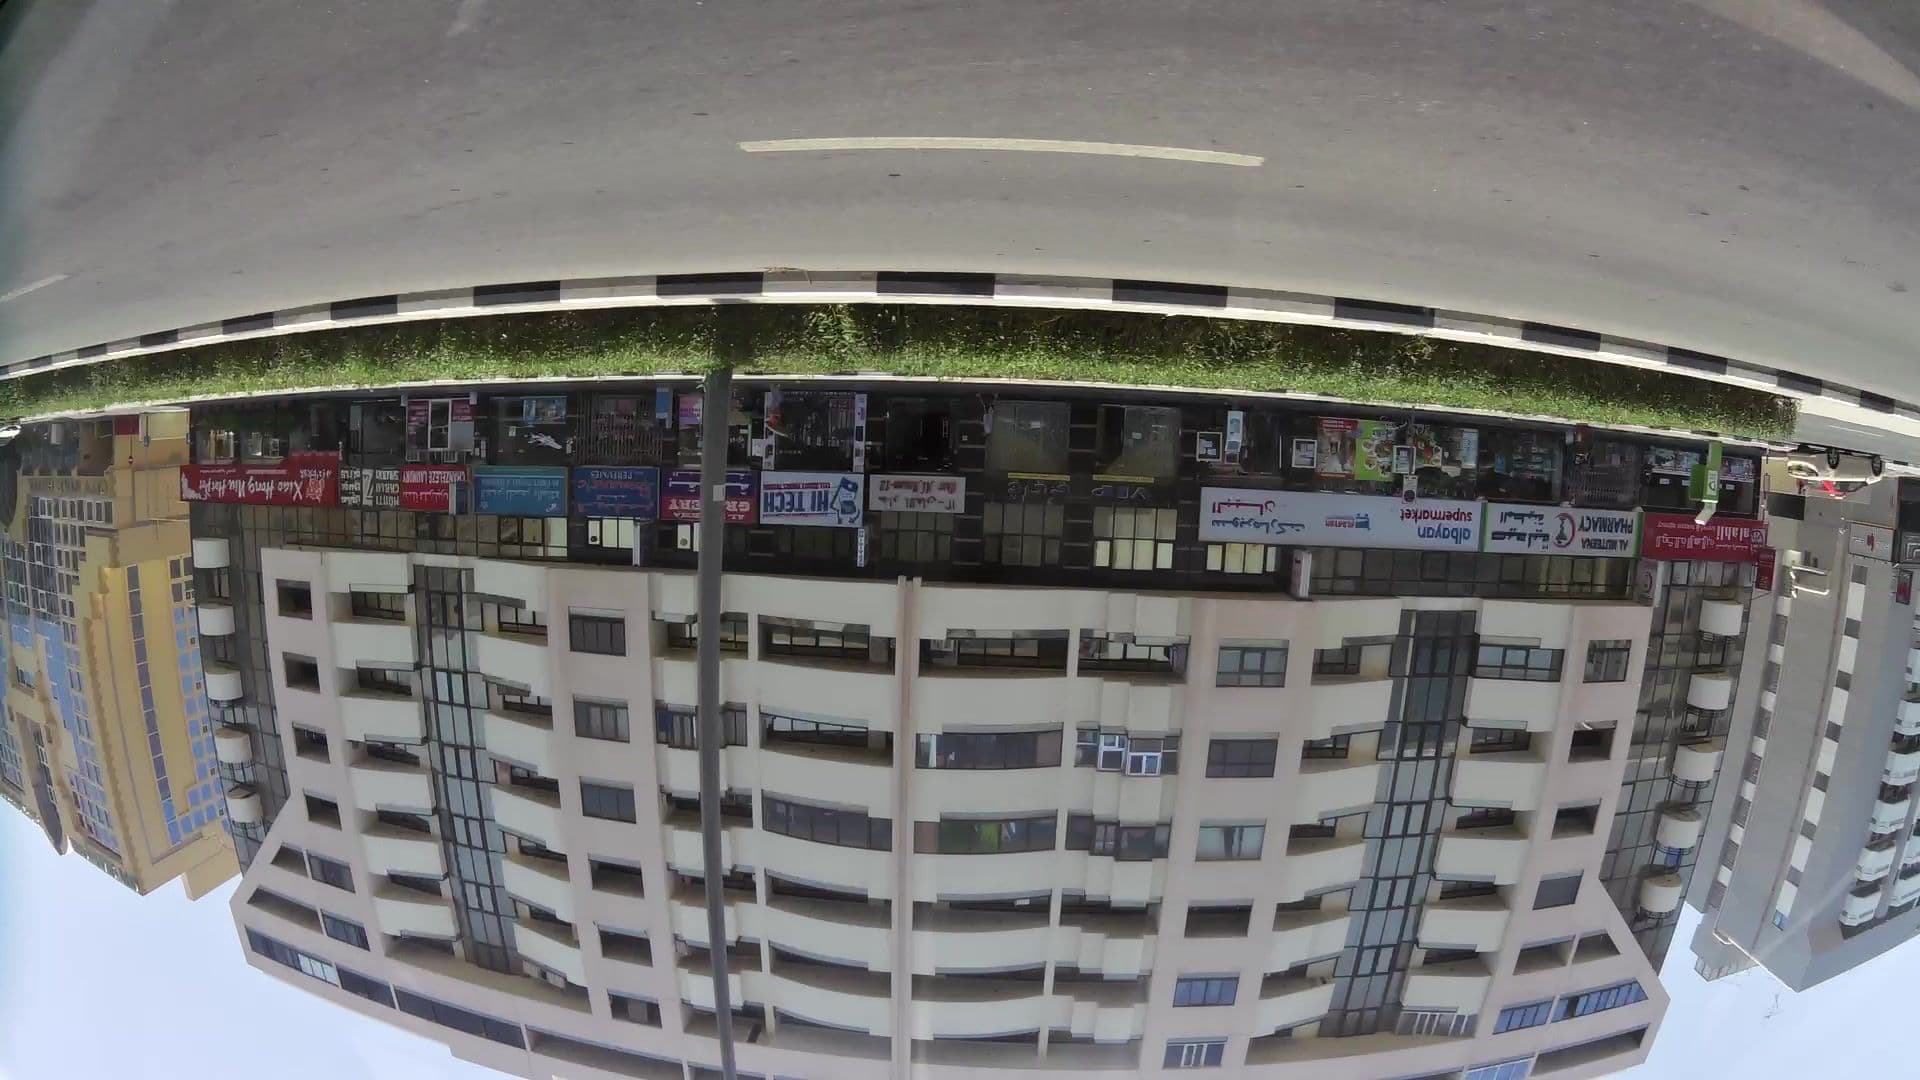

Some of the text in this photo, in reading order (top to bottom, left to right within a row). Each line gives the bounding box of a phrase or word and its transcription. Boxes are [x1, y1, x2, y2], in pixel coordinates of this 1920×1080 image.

[250, 476, 274, 501] Hong
[668, 498, 750, 512] GRERY
[763, 490, 830, 513] HI TECH
[1212, 498, 1276, 516] البيان
[1400, 508, 1472, 524] supermarket
[1578, 516, 1634, 534] PHARMACY
[1212, 517, 1306, 535] سوبرماركت
[1417, 523, 1471, 544] albayan
[1491, 528, 1550, 550] صيدلية
